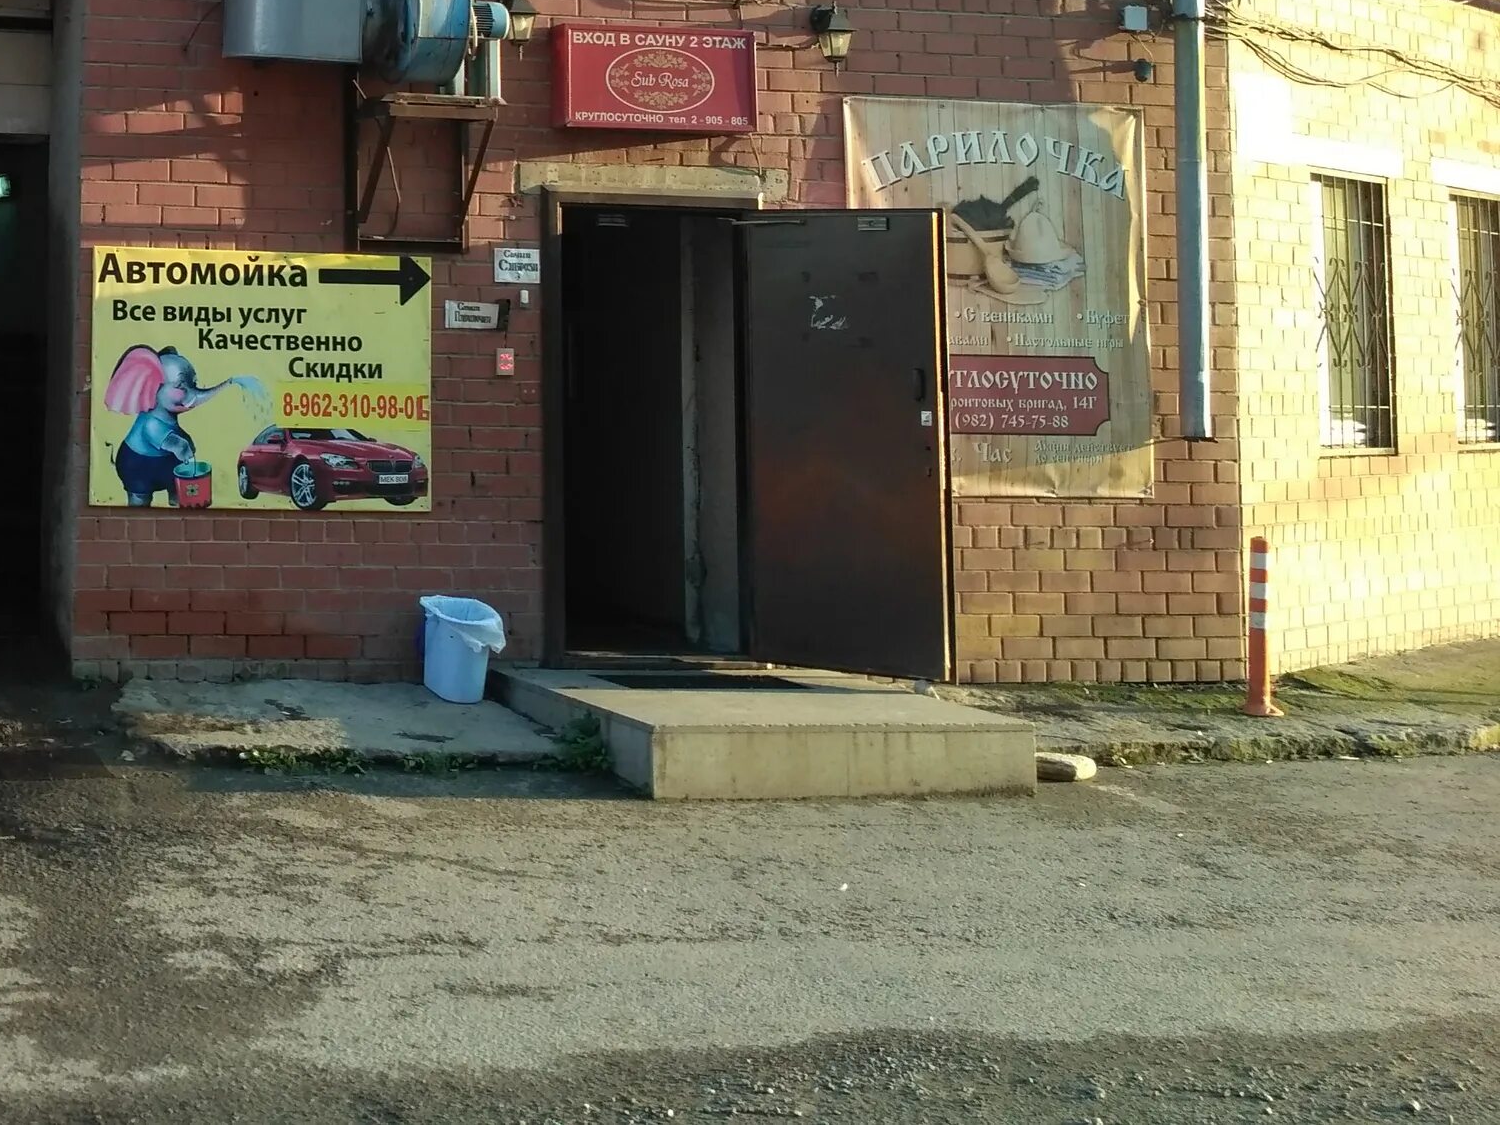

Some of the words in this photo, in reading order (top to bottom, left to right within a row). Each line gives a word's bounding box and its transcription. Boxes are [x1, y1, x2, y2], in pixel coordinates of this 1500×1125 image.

[572, 31, 616, 47] ВХОД
[620, 34, 631, 45] В
[634, 34, 686, 48] САУНУ
[689, 36, 698, 48] 2
[702, 36, 747, 49] ЭТАЖ
[630, 71, 656, 88] Sub
[658, 72, 689, 89] Rosa
[575, 111, 664, 124] КРУГЛОСУТОЧНО
[668, 116, 686, 124] тел
[861, 130, 1130, 201] ПАРИЛОЧКА
[98, 252, 308, 287] Автомойка
[112, 299, 156, 321] Все
[163, 305, 232, 326] виды
[238, 306, 307, 329] услуг
[980, 310, 1054, 324] вениками
[198, 328, 363, 352] Качественно
[1014, 333, 1093, 348] Настольные
[288, 356, 383, 383] Скидки
[949, 370, 1098, 394] ГЛОСУТОЧНО
[1073, 396, 1097, 409] 14Г
[955, 412, 994, 430] (982)
[1001, 415, 1069, 428] 745-75-88
[972, 442, 1013, 463] Час
